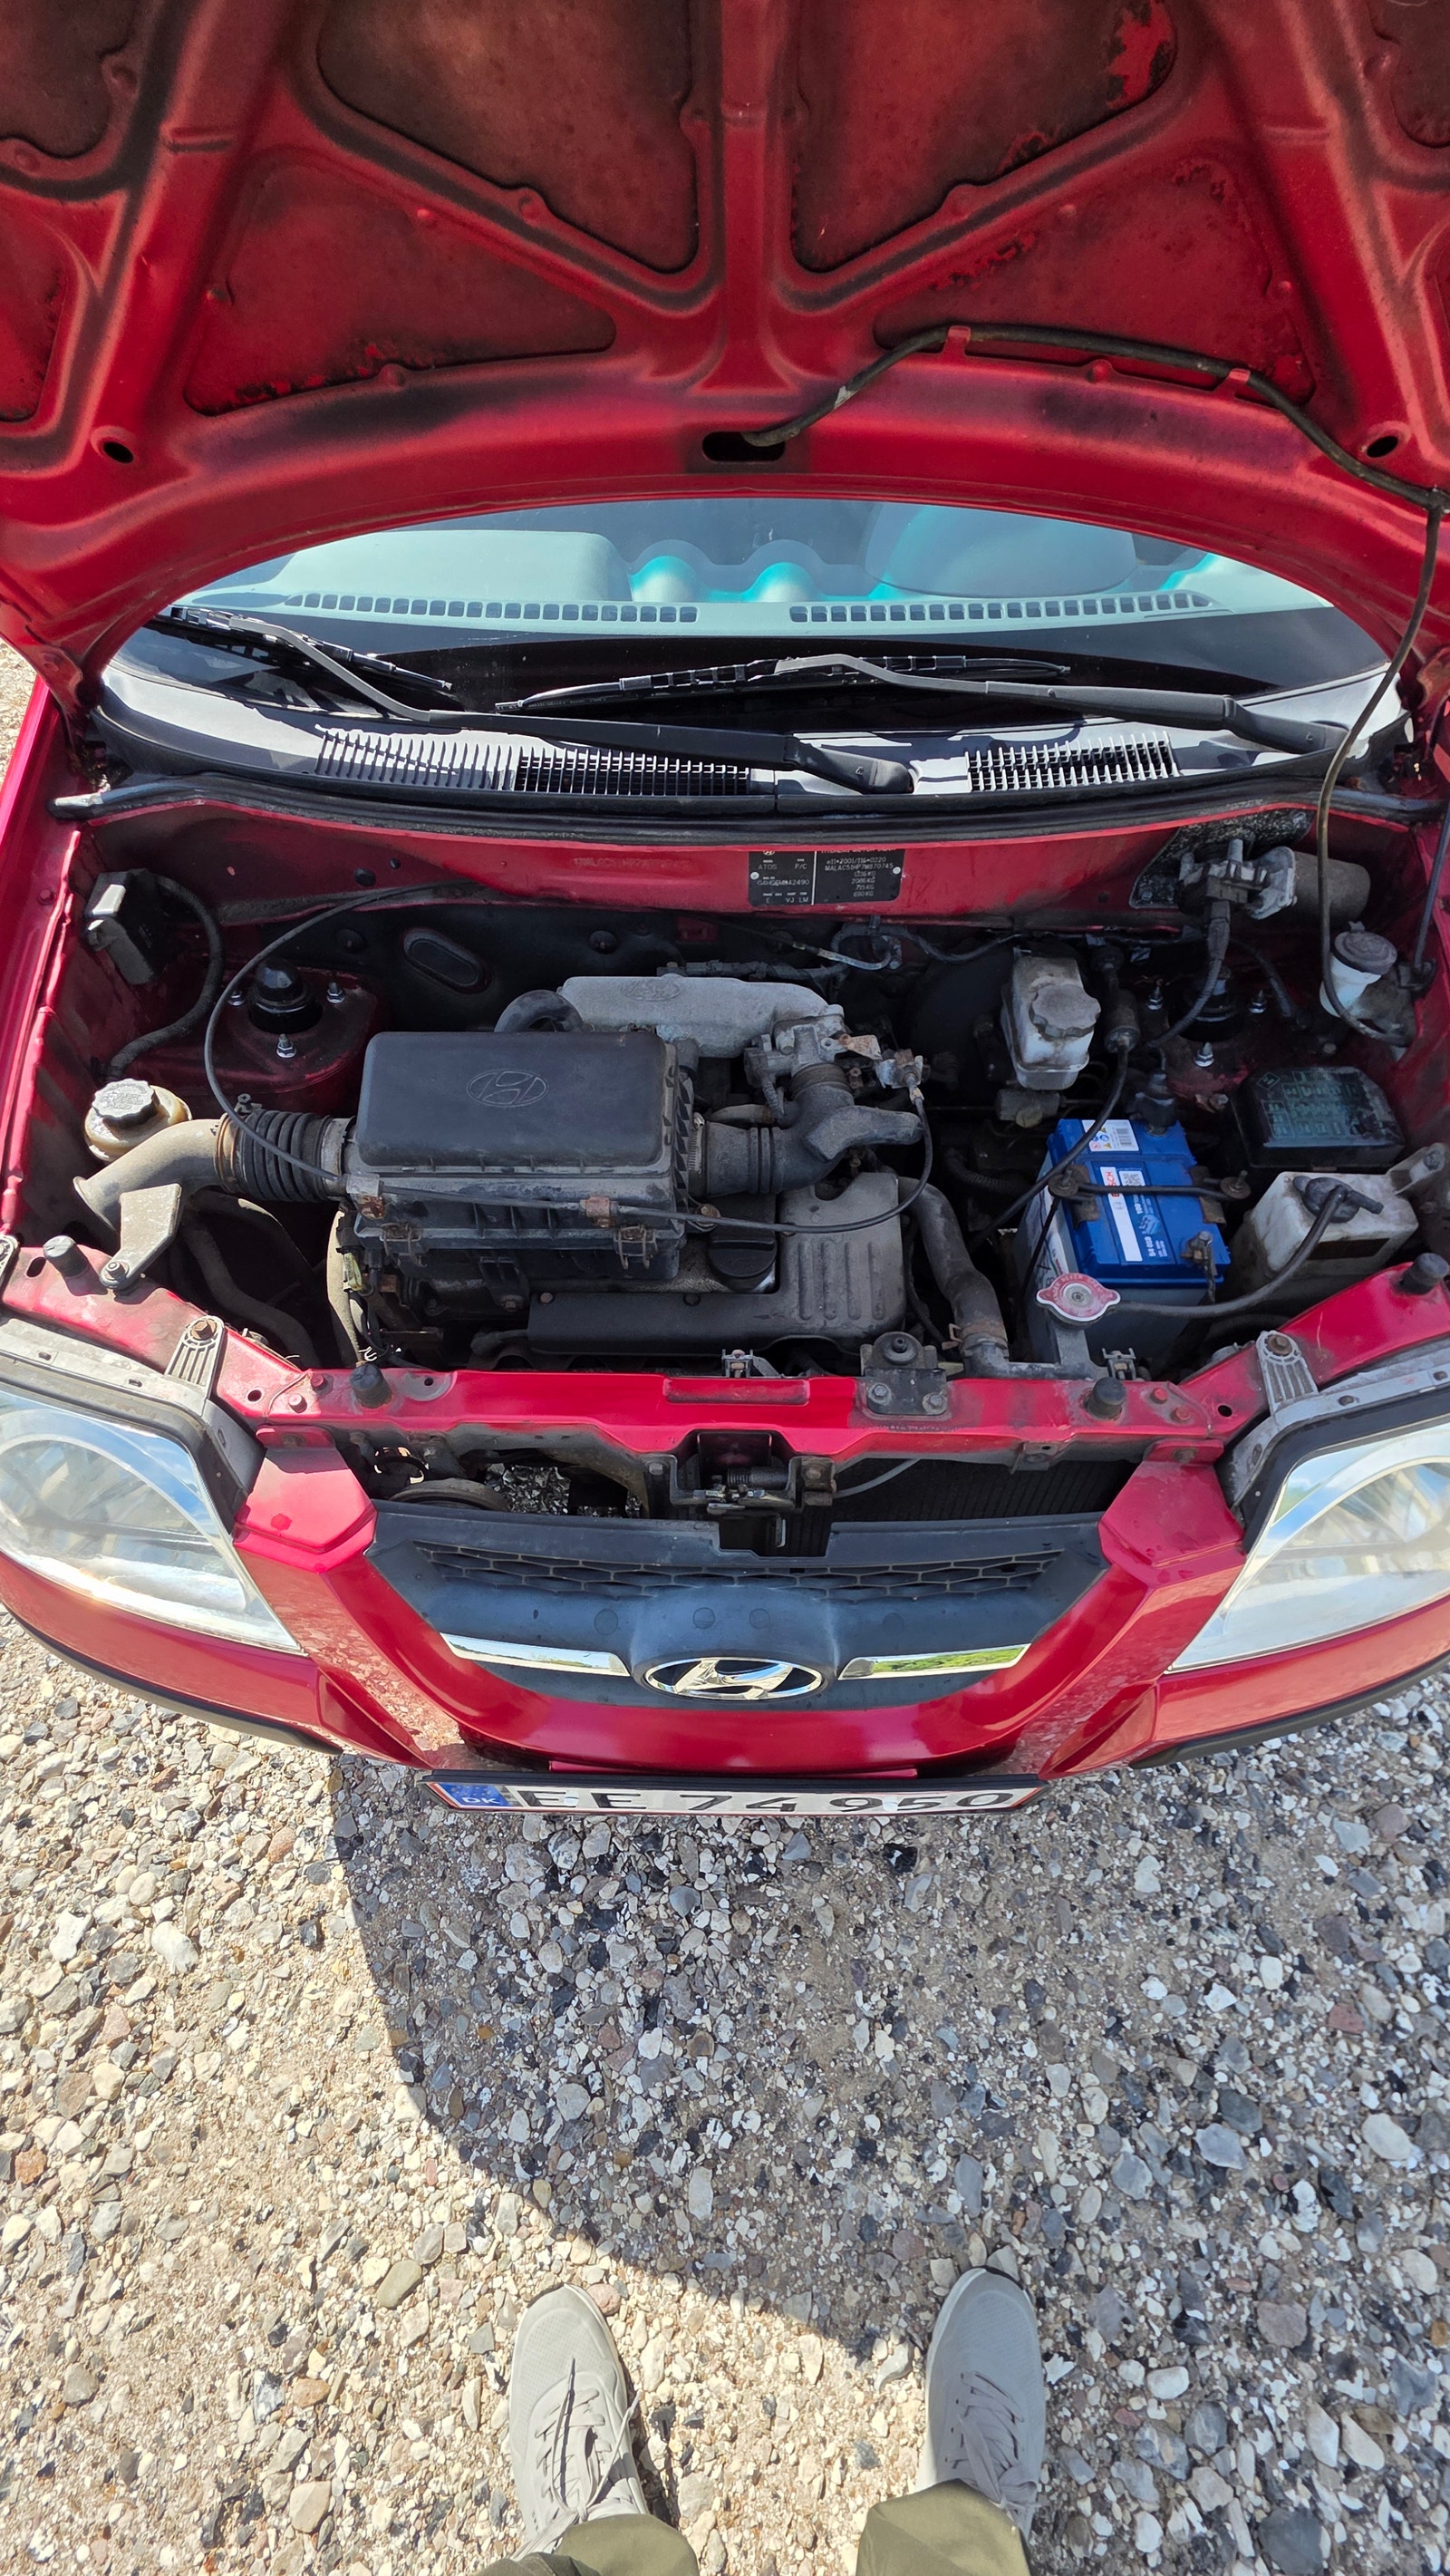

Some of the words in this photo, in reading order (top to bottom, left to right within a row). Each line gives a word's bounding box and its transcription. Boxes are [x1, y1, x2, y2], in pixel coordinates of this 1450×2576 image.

[1106, 1171, 1120, 1196] BSCH
[517, 1790, 647, 1810] EE
[680, 1794, 798, 1812] 74
[829, 1793, 1013, 1812] 950
